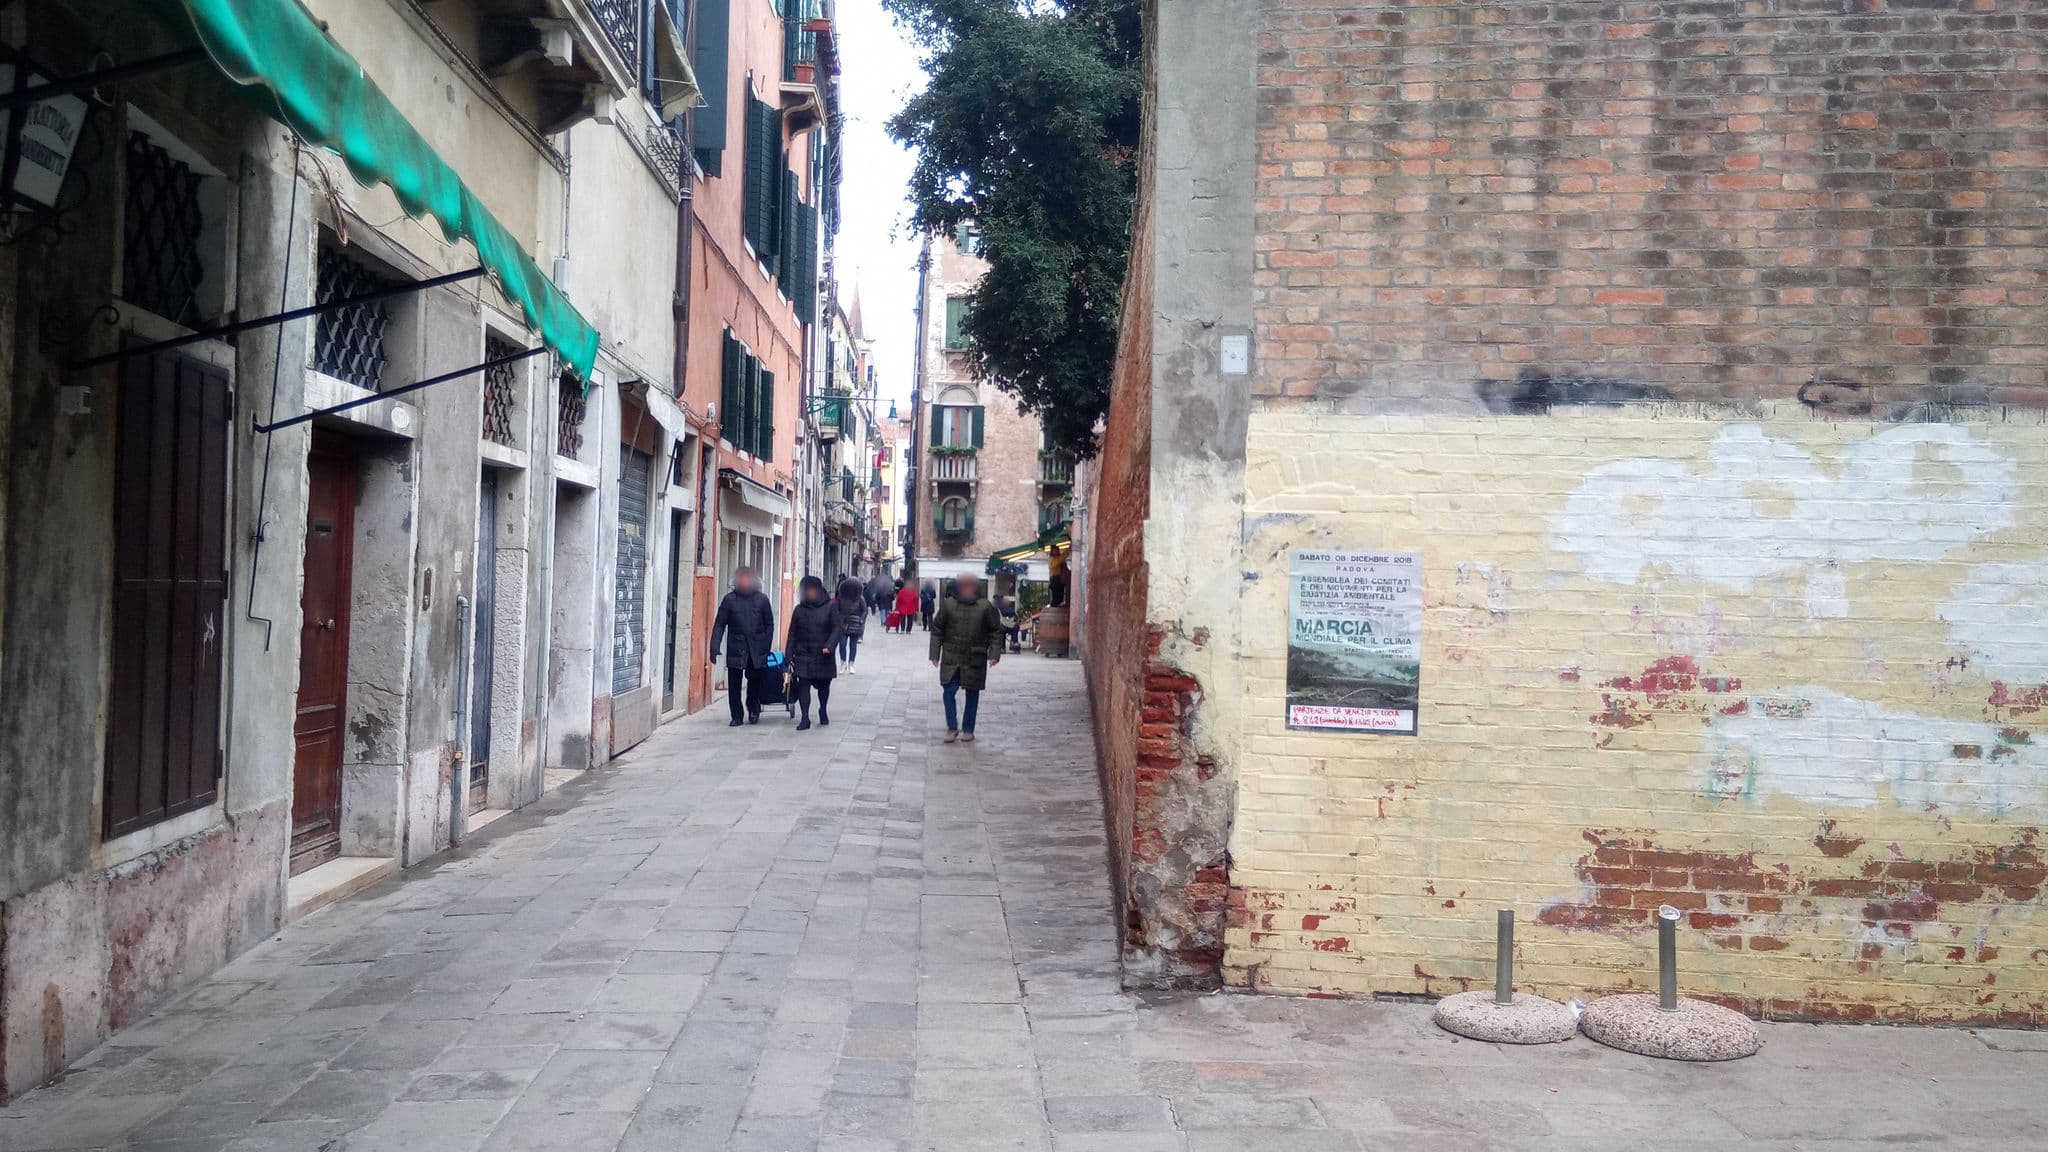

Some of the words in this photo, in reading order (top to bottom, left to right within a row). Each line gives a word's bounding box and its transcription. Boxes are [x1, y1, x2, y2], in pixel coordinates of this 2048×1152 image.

[1299, 554, 1331, 562] SABATO
[1335, 554, 1346, 562] 08
[1350, 555, 1389, 563] DICEMBRE
[1393, 556, 1413, 564] 2018
[1300, 575, 1350, 584] ASSEMBLEA
[1354, 577, 1368, 585] DEI
[1371, 578, 1411, 586] COMITATI
[1326, 584, 1373, 592] MOVIMENTI
[1376, 585, 1393, 593] PER
[1300, 591, 1339, 599] GIUSTIZIA
[1343, 592, 1396, 601] AMBIENTALE
[1296, 619, 1373, 636] MARCIA
[1295, 634, 1343, 644] MONDIALE
[1347, 636, 1366, 645] PER
[1371, 637, 1379, 645] IL
[1382, 637, 1412, 645] CLIMA
